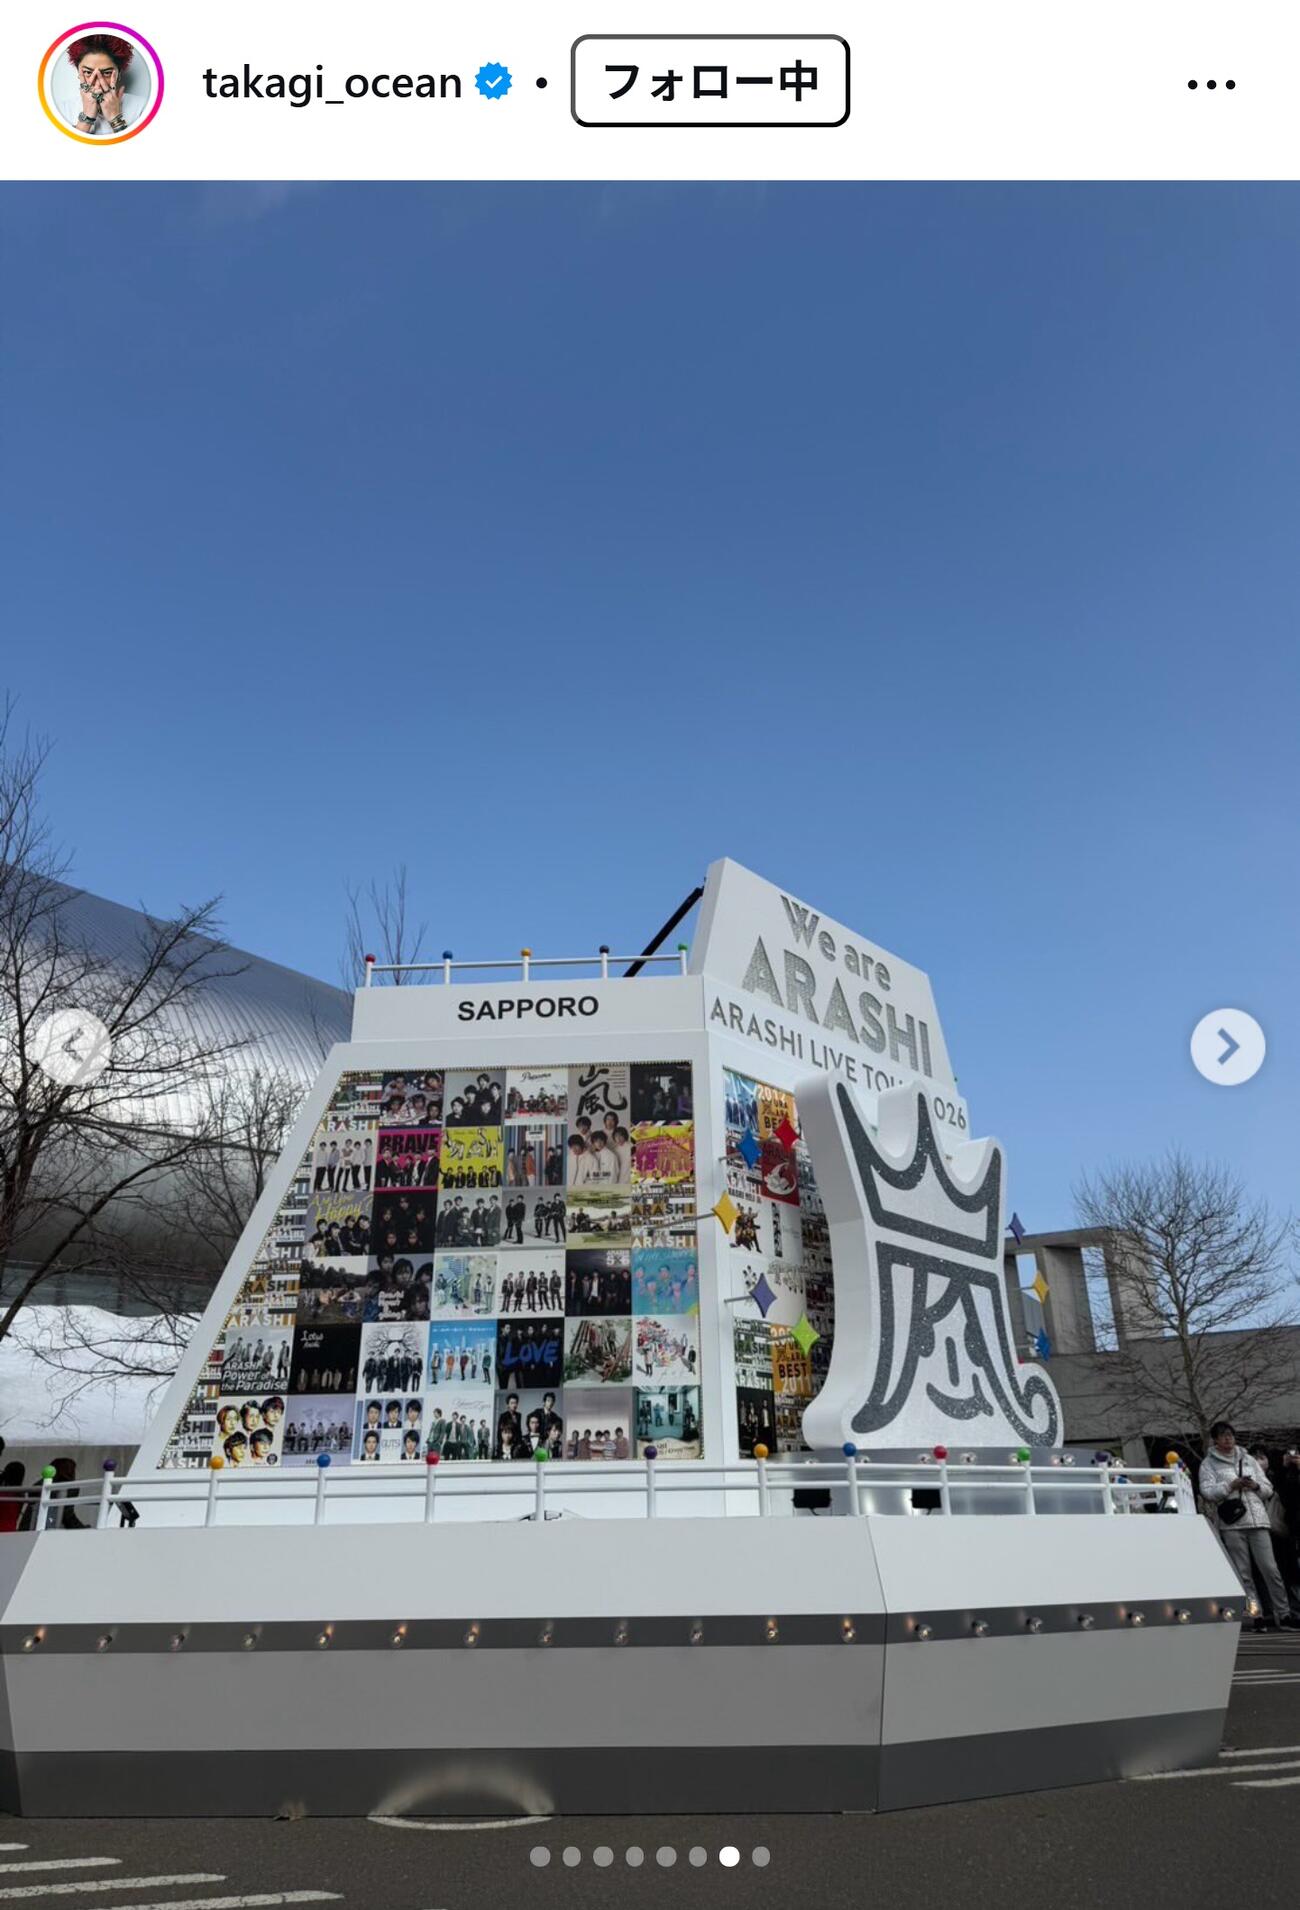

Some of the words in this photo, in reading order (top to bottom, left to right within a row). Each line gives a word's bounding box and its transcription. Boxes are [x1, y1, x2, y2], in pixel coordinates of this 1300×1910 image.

[781, 895, 836, 962] We
[844, 944, 891, 991] are
[458, 996, 599, 1021] SAPPORO
[742, 936, 932, 1077] ARASHI
[709, 997, 803, 1060] ARASHI
[810, 1039, 857, 1083] LIVE
[862, 1063, 903, 1092] TO
[934, 1097, 966, 1130] 026
[632, 1236, 695, 1249] ARASHI
[502, 1340, 559, 1366] LOVE
[222, 1371, 259, 1381] Power
[779, 1363, 807, 1378] BEST
[235, 1380, 289, 1392] Paradise
